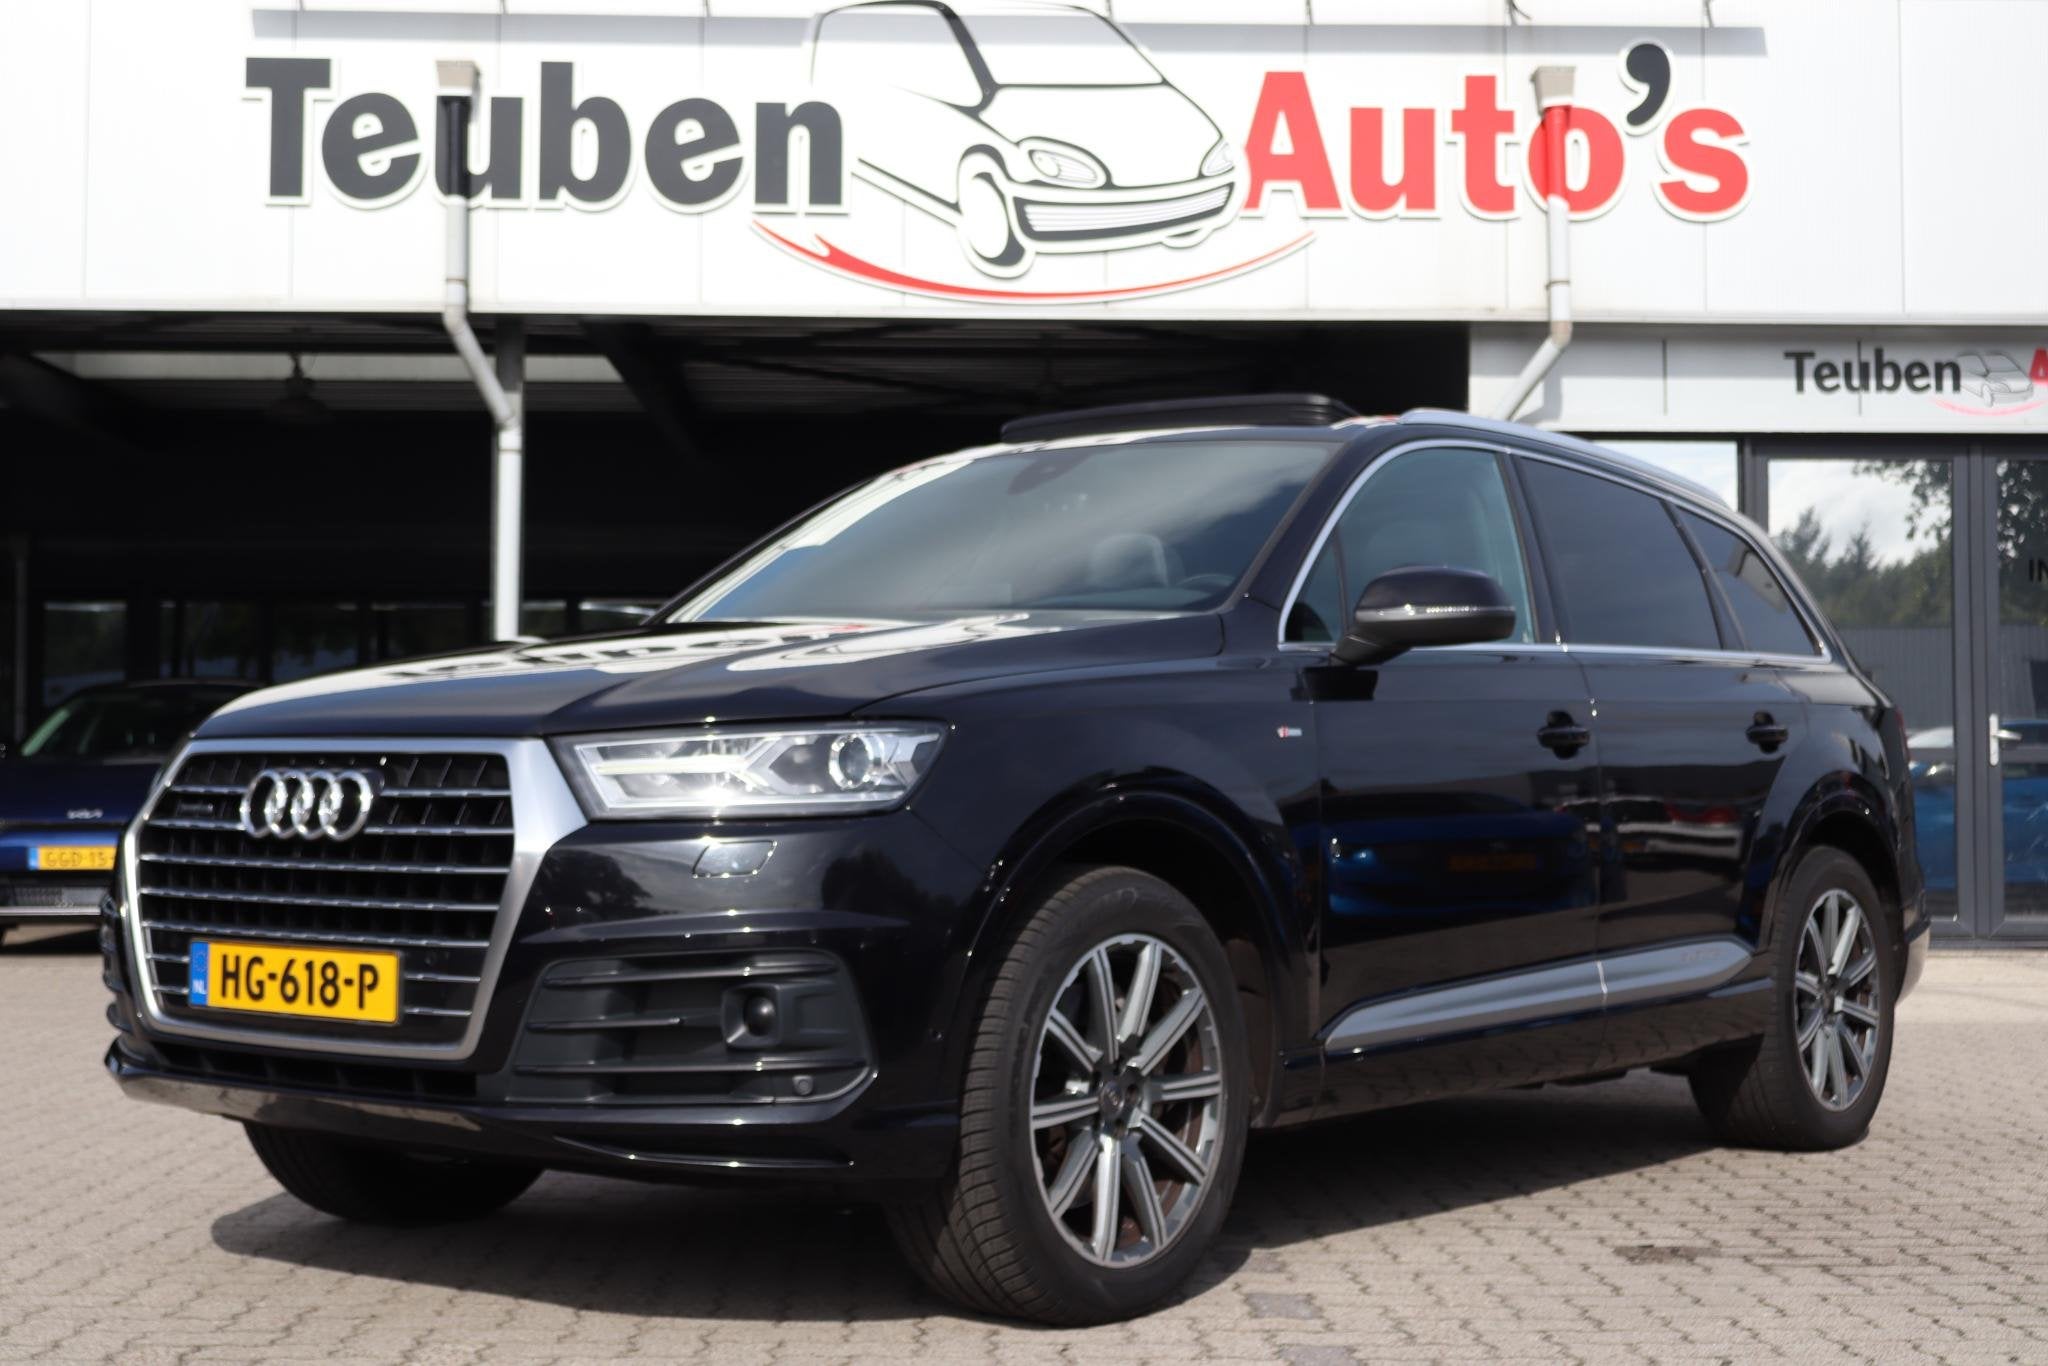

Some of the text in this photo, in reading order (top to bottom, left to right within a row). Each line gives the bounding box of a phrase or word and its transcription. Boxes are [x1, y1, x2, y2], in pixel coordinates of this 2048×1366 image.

[246, 43, 1749, 213] Teuben Auto's
[1784, 347, 1961, 393] Teuben
[222, 954, 378, 1010] HG-618-P
